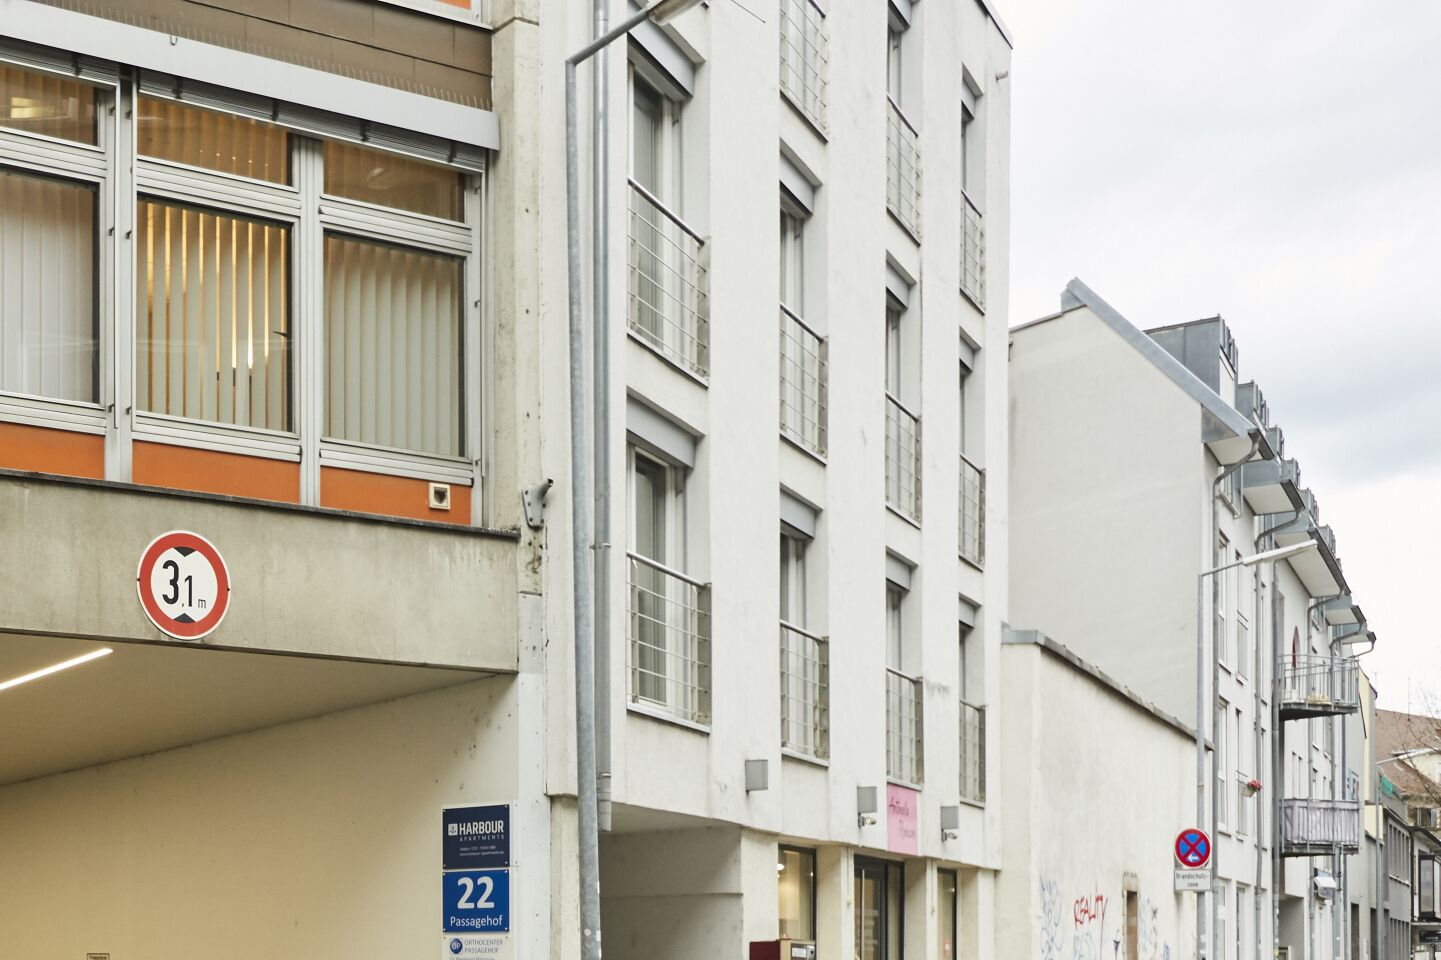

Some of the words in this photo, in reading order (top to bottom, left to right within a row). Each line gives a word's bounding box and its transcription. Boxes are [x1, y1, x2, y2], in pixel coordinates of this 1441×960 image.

[197, 598, 207, 609] m
[459, 820, 505, 836] HARBOUR
[459, 834, 505, 842] APARTMENTS
[457, 875, 495, 910] 22
[450, 914, 503, 928] Passagehof
[464, 938, 503, 946] ORTHOCENTER
